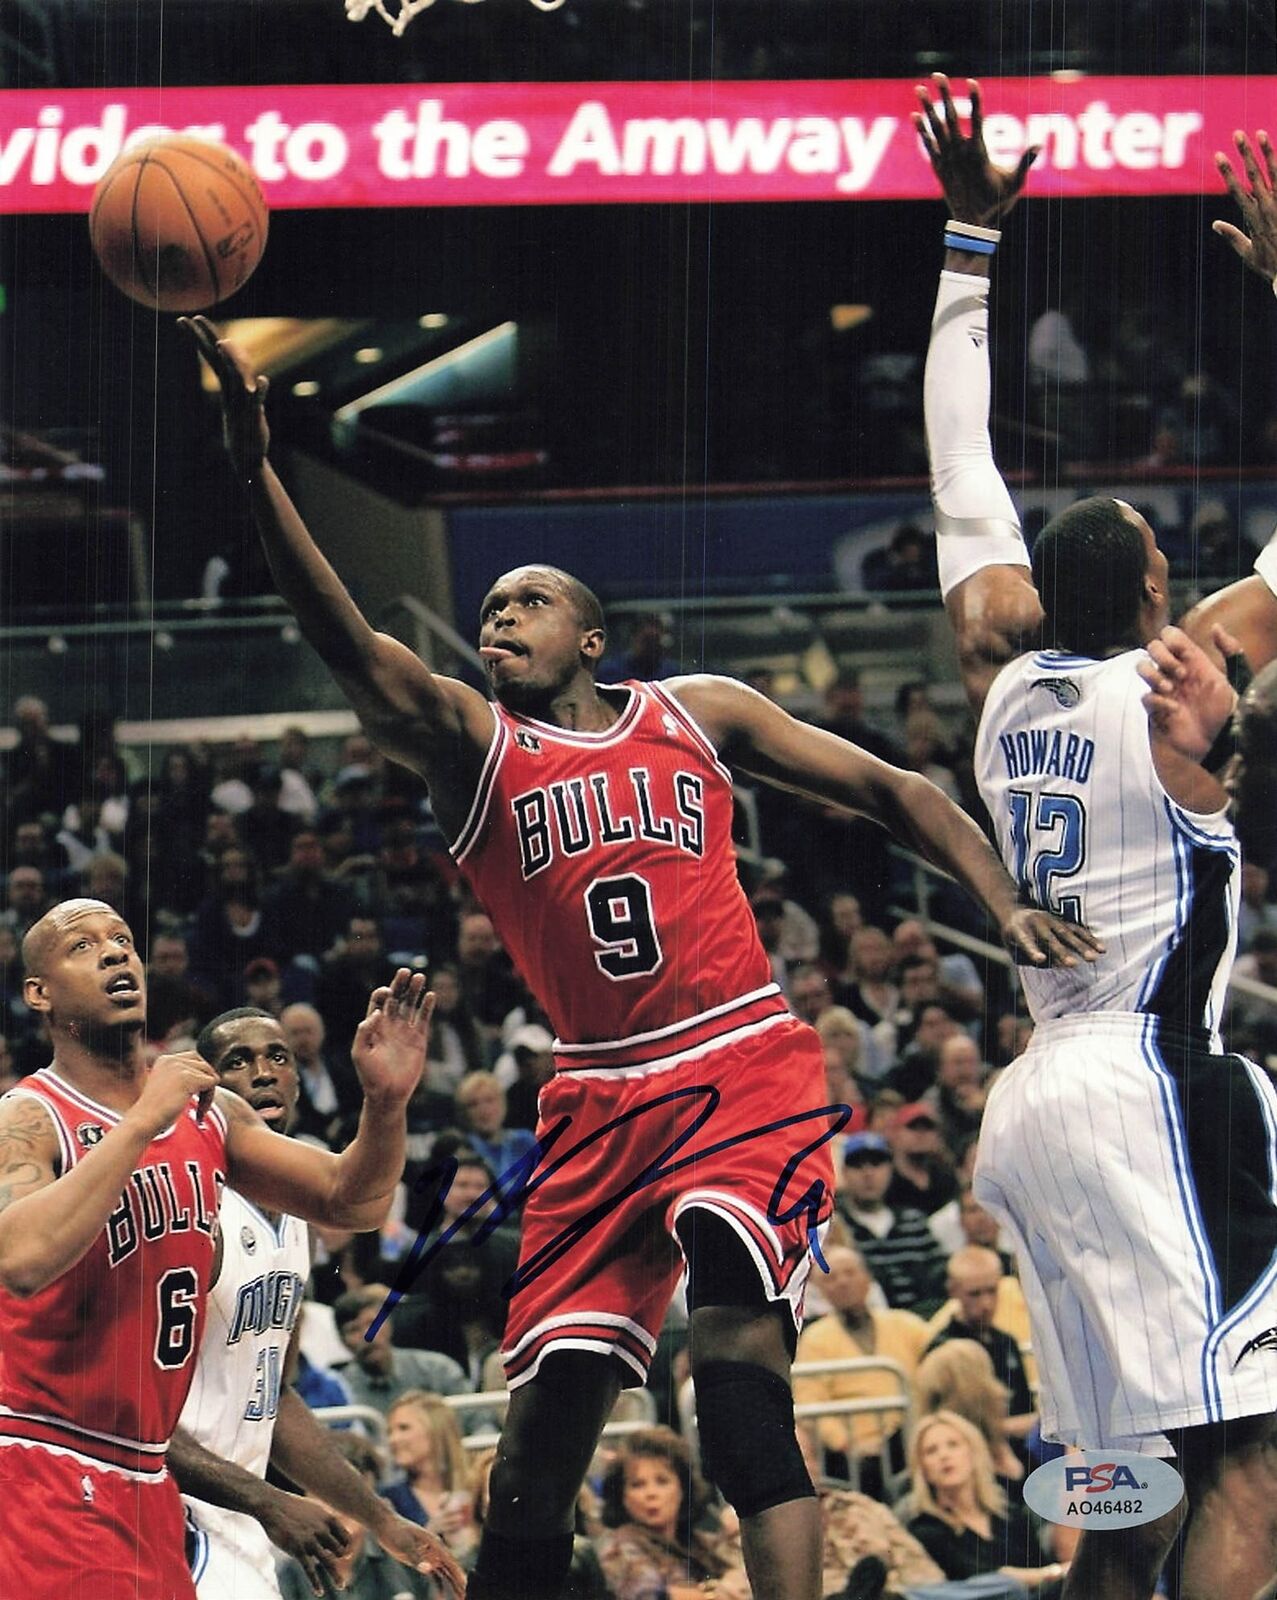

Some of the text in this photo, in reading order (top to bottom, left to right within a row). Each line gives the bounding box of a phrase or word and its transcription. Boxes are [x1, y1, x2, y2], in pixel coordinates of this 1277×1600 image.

[245, 110, 347, 181] to
[373, 99, 530, 181] the
[547, 101, 897, 192] Amway
[999, 730, 1095, 785] HOWARD
[510, 767, 704, 882] BULLS
[1008, 789, 1086, 926] 12
[583, 872, 664, 982] 9
[153, 1266, 199, 1371] 6
